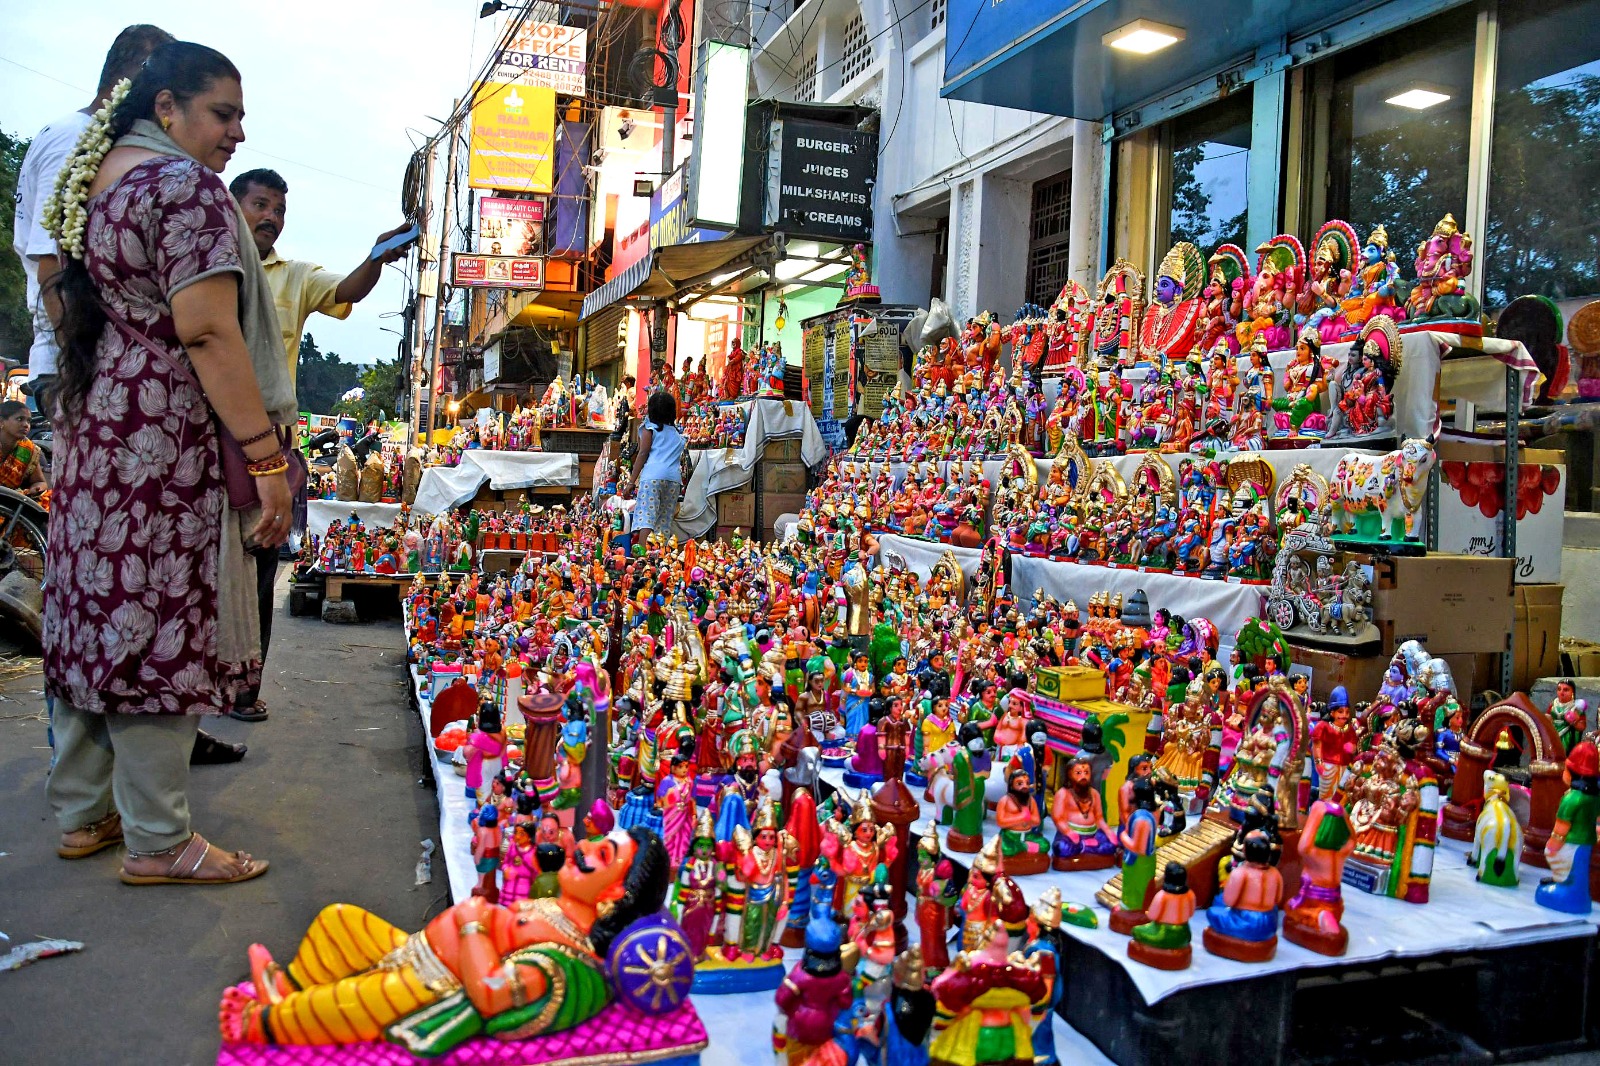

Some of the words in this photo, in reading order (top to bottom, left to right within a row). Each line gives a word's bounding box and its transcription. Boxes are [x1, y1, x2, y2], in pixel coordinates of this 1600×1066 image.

[502, 36, 581, 59] OFFICE
[501, 51, 533, 68] FOR
[537, 56, 580, 74] RENT
[497, 114, 530, 126] RAJA
[476, 126, 549, 141] RAJESWARI
[802, 163, 849, 178] JUICES
[782, 184, 866, 204] MILKSHAKES
[506, 203, 527, 212] BEAUTY
[527, 205, 542, 213] CARE
[459, 260, 478, 268] ARUN
[1469, 536, 1496, 555] Fruit
